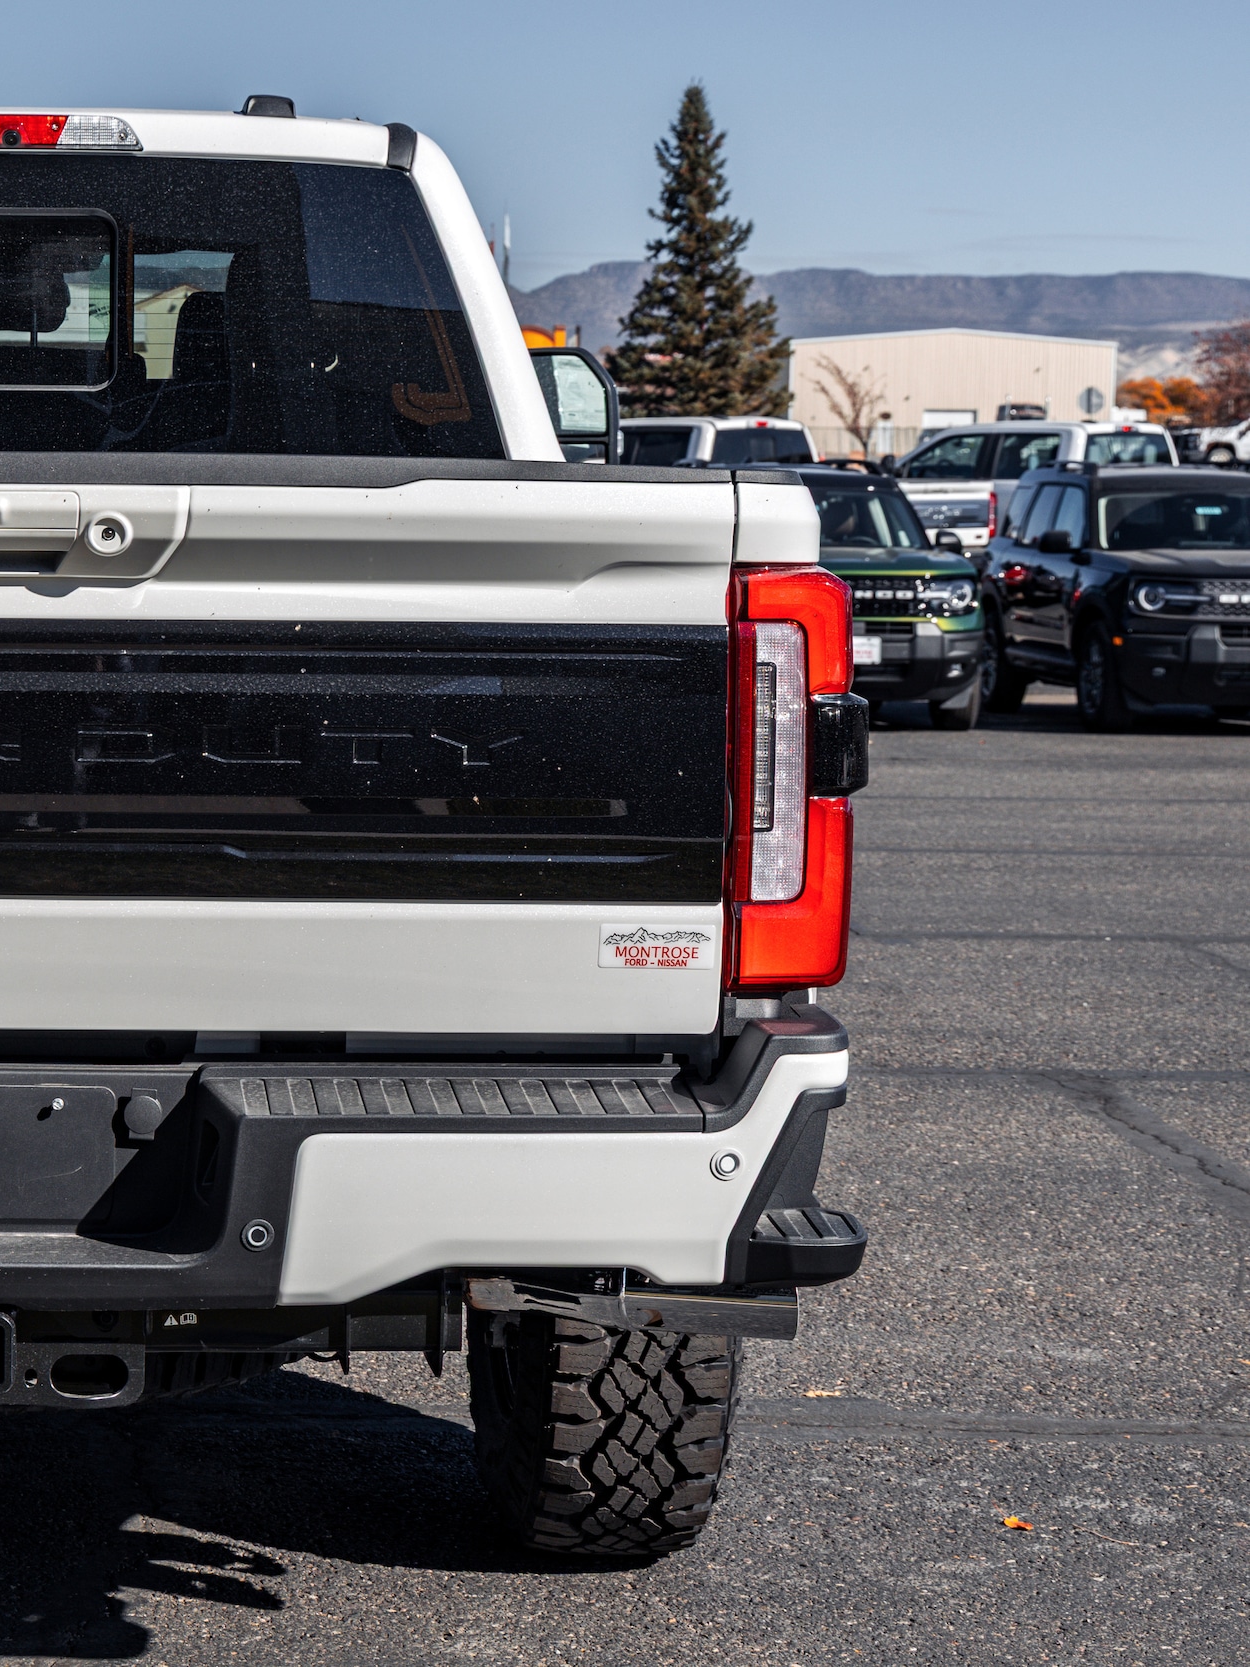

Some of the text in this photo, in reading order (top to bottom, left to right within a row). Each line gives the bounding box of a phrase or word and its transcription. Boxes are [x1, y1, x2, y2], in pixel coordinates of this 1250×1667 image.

[75, 723, 525, 766] DUTY
[615, 946, 699, 959] MONTROSE
[657, 959, 688, 967] NISSAN
